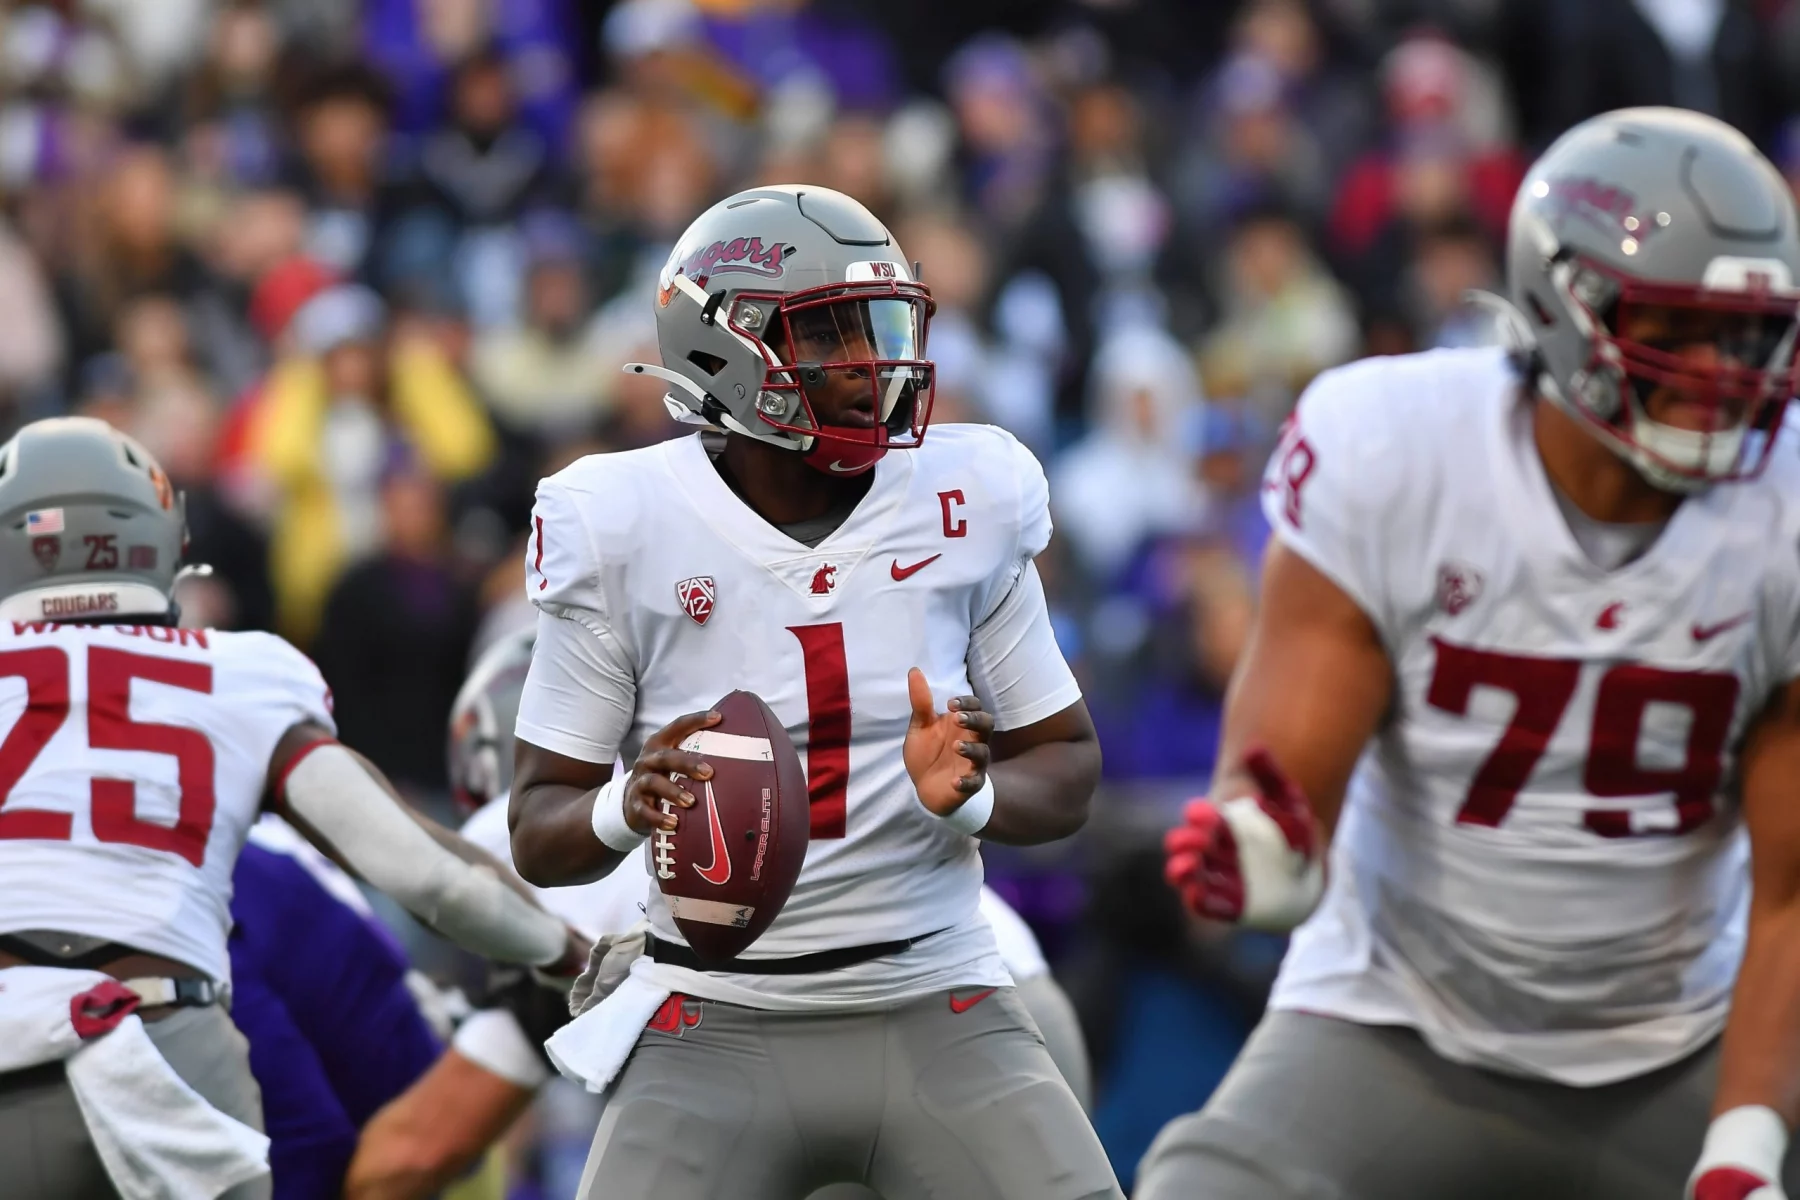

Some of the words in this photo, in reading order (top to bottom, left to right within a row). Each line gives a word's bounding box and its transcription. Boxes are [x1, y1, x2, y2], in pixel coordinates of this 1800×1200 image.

[869, 262, 897, 278] WSU
[938, 489, 968, 538] C
[83, 534, 119, 570] 25
[41, 592, 118, 618] COUGARS
[677, 577, 714, 608] PAC
[689, 596, 710, 617] 12
[786, 622, 852, 840] 1
[1426, 637, 1741, 837] 79
[0, 644, 215, 868] 25
[760, 787, 771, 833] ELITE
